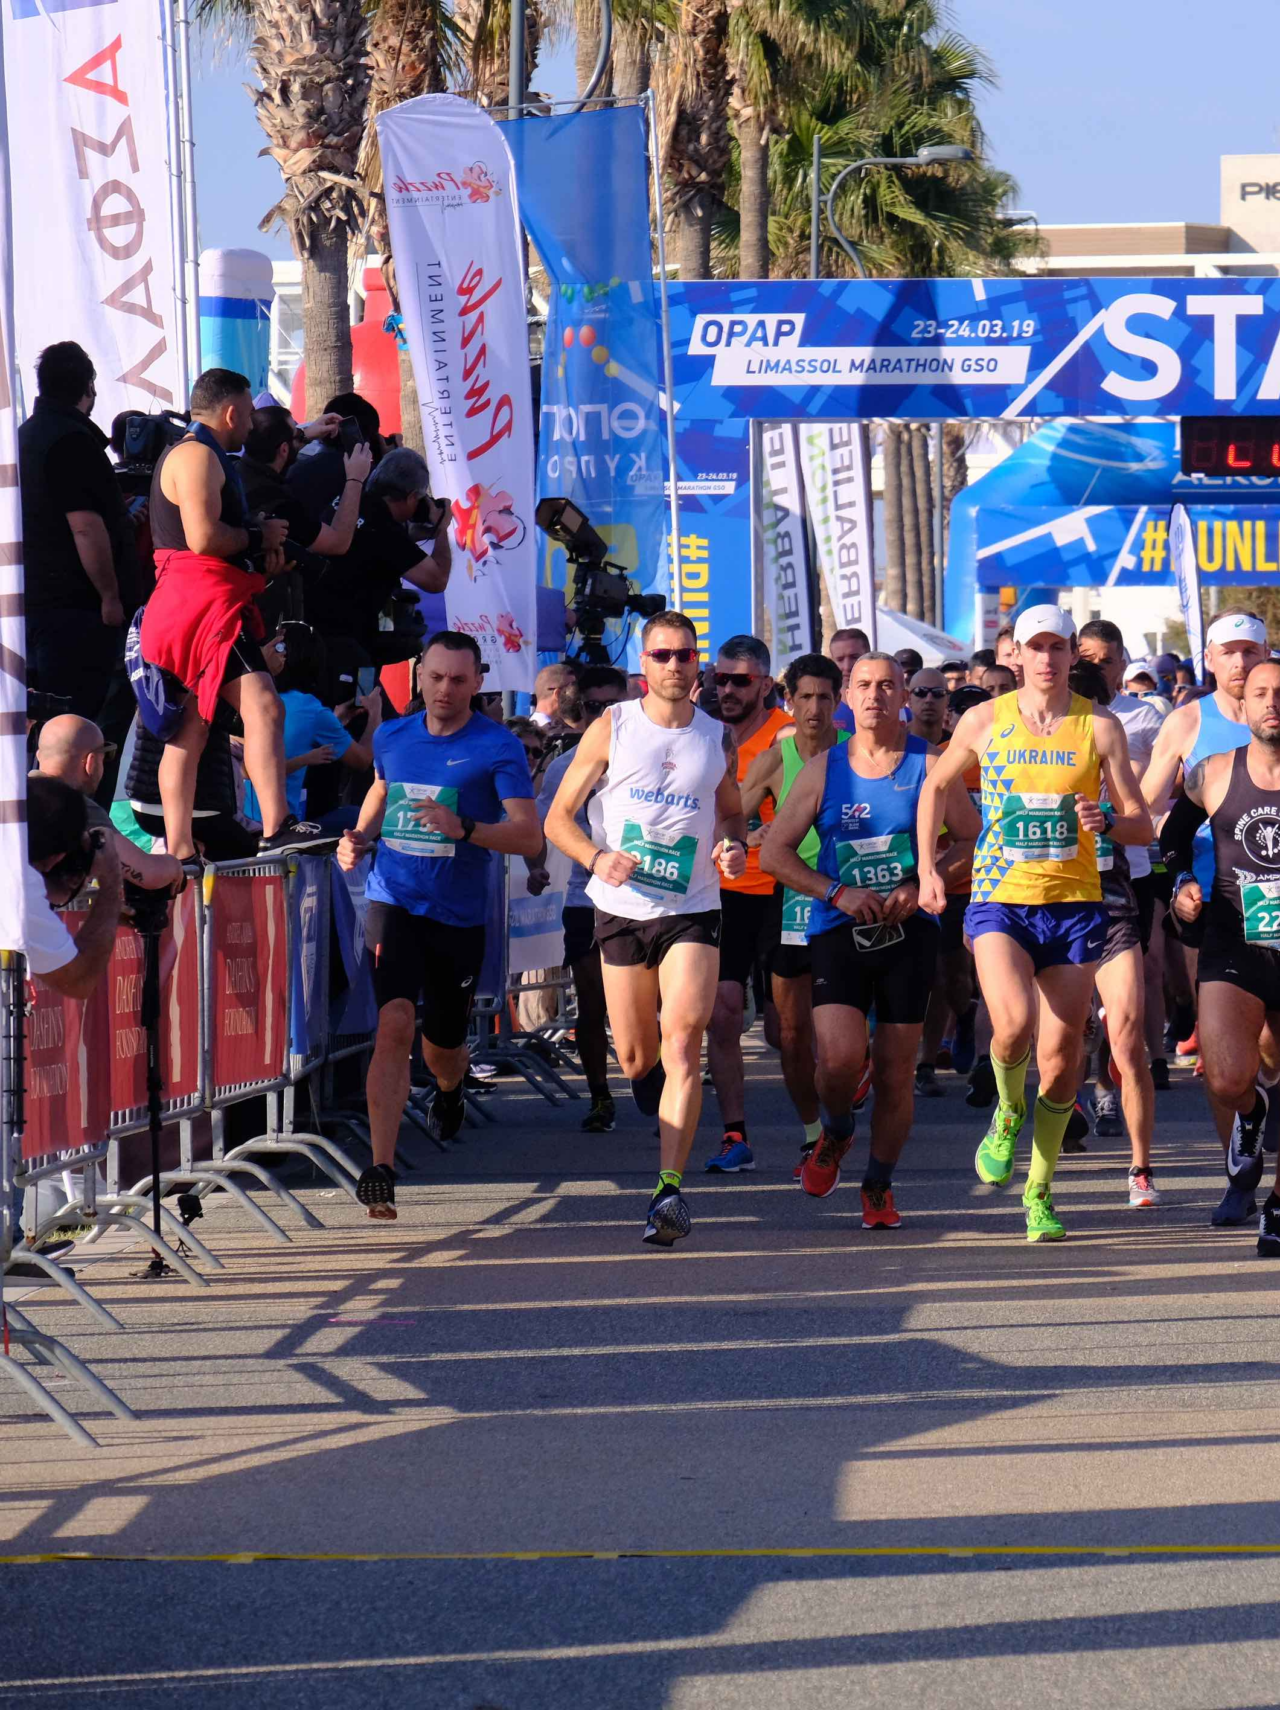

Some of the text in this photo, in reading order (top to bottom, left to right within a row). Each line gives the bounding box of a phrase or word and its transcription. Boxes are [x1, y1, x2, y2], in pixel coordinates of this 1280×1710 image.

[700, 319, 796, 349] OPAP
[911, 319, 1035, 340] 23-24.03.19
[745, 356, 999, 375] LIMASSOL MARATHON GSO
[1006, 749, 1077, 767] UKRAINE
[1016, 821, 1068, 840] 1618
[1234, 813, 1251, 841] SPINE
[1250, 806, 1278, 818] CARE
[852, 862, 903, 887] 1363
